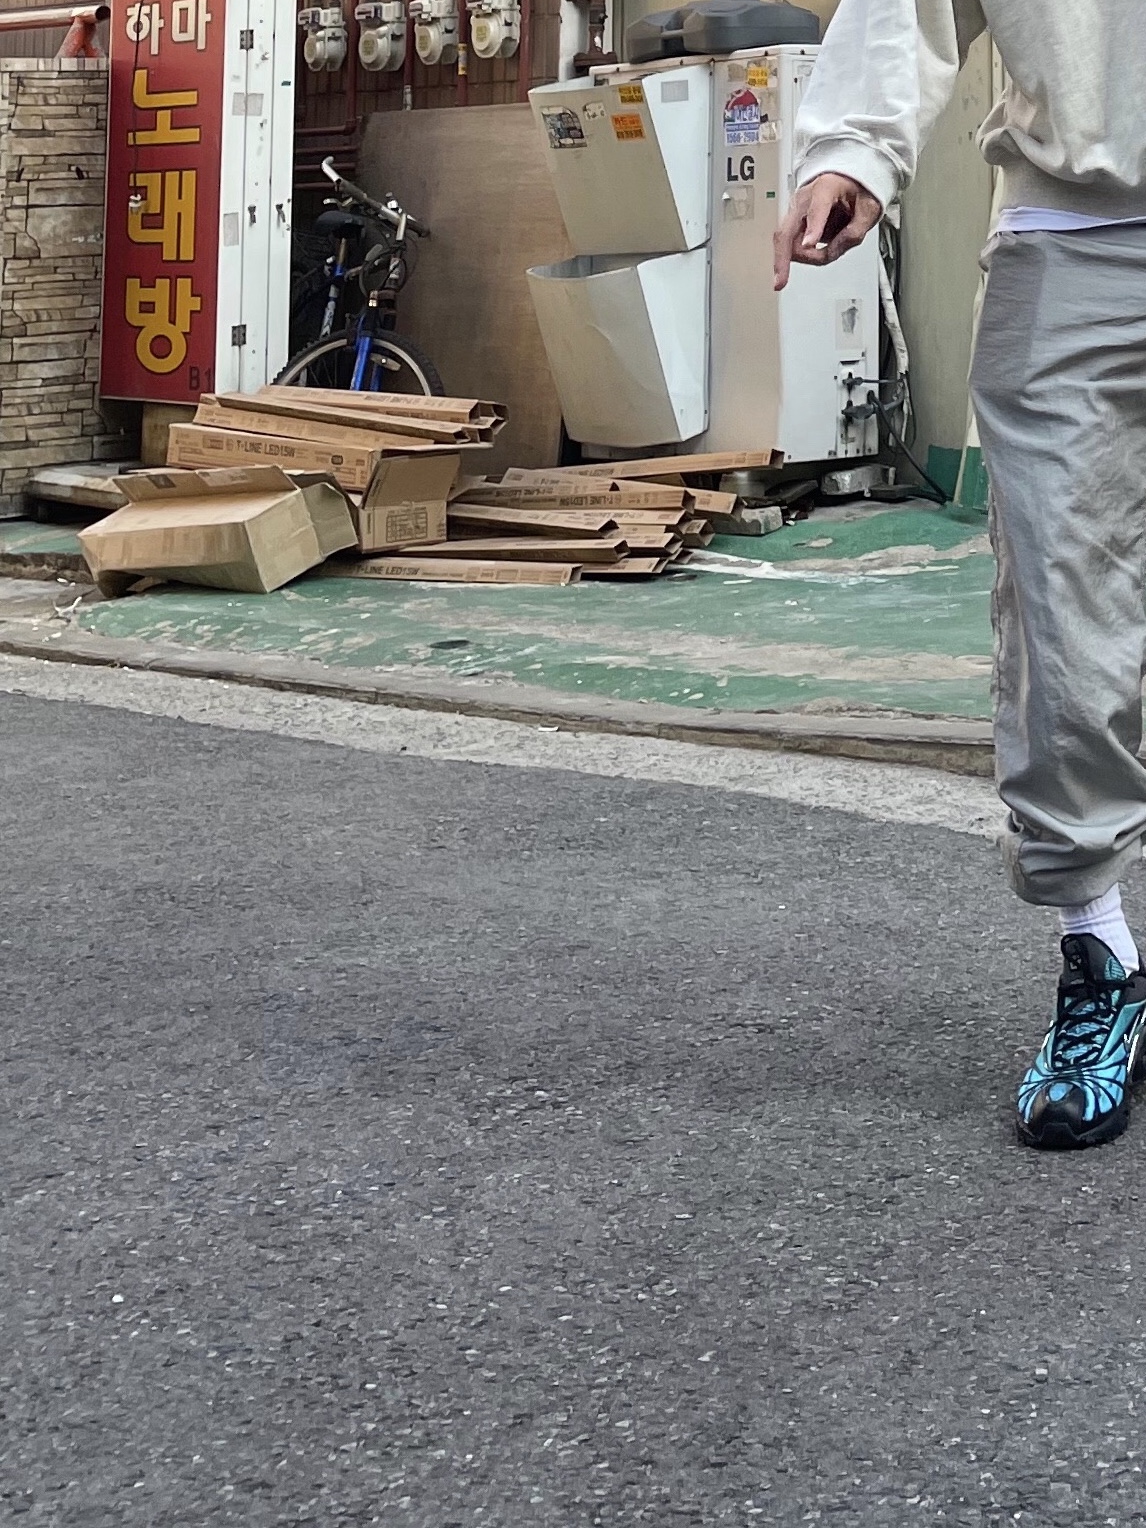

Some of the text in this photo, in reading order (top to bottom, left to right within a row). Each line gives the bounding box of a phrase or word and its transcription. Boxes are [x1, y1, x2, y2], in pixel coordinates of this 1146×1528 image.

[726, 155, 755, 182] LG
[125, 69, 202, 373] 노래방
[189, 366, 211, 392] B1
